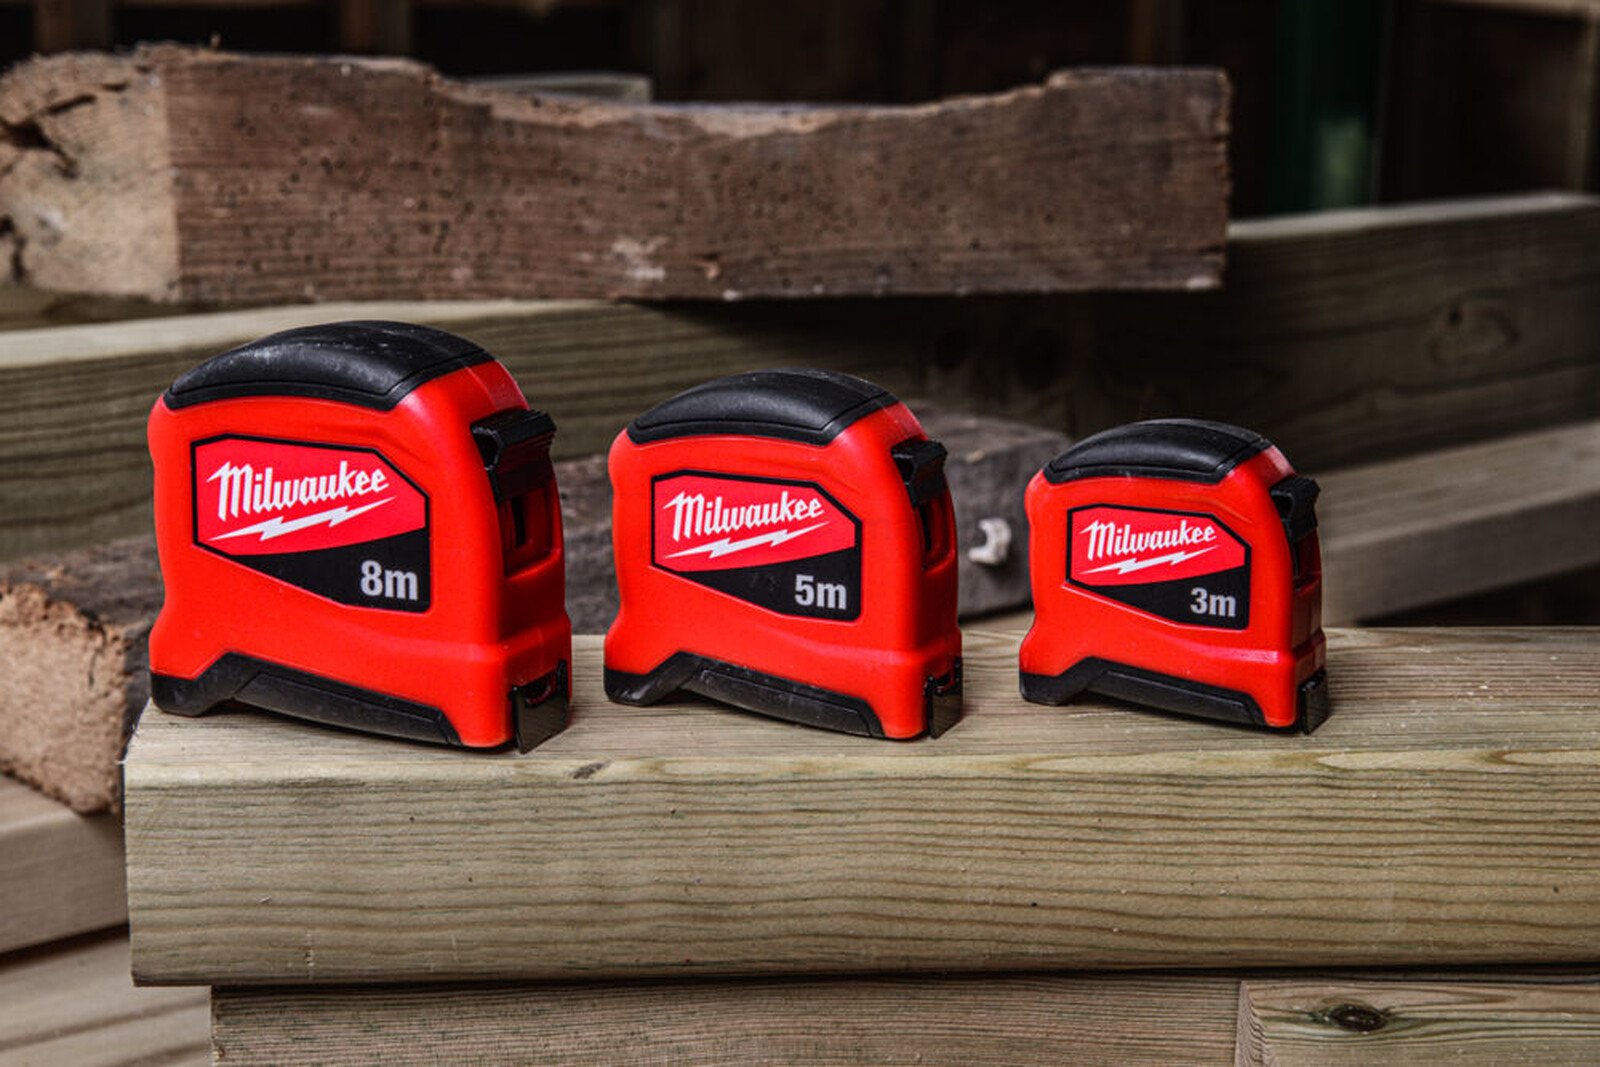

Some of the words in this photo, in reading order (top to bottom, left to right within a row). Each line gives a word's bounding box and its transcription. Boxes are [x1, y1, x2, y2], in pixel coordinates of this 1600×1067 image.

[206, 460, 390, 521] Milwaukee
[663, 491, 826, 542] Milwaukee
[1079, 519, 1217, 561] Milwaukee
[360, 560, 419, 600] 8m
[794, 574, 848, 610] 5m
[1190, 587, 1237, 618] 3m
